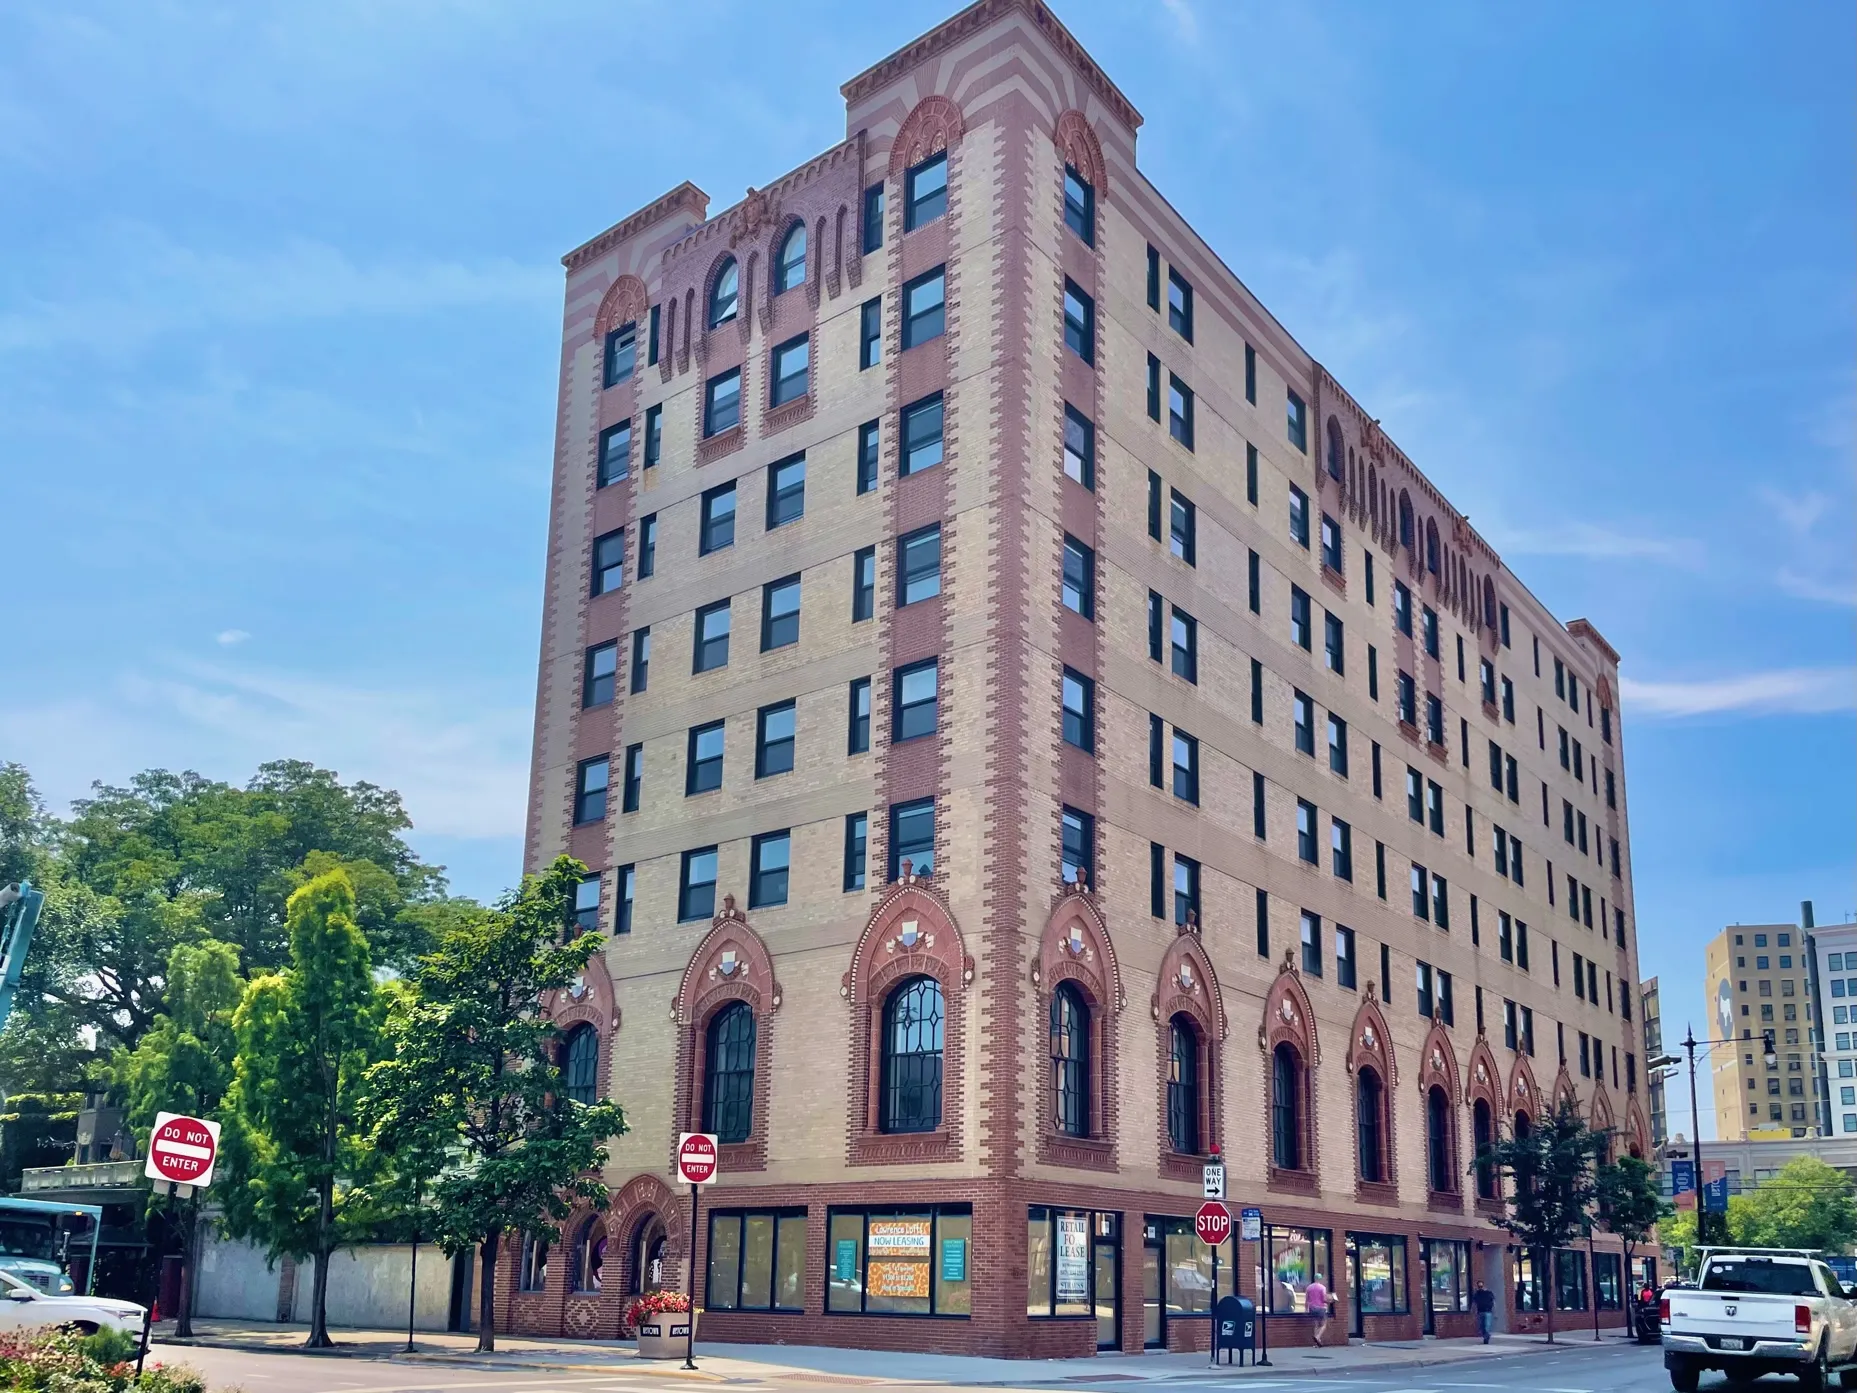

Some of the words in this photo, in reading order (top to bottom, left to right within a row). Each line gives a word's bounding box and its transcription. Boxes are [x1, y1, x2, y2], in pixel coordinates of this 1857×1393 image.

[164, 1127, 180, 1139] DO
[186, 1131, 209, 1144] NOT
[685, 1143, 695, 1151] DO
[698, 1144, 712, 1152] NOT
[162, 1156, 199, 1171] ENTER
[686, 1165, 708, 1173] ENTER
[1206, 1168, 1221, 1176] ONE
[1206, 1177, 1221, 1185] WAY
[1060, 1221, 1085, 1233] RETAIL
[1198, 1215, 1228, 1232] STOP
[874, 1237, 891, 1246] NOW
[893, 1236, 924, 1246] LEASING
[1064, 1234, 1080, 1246] FO
[1060, 1245, 1085, 1257] LEASE
